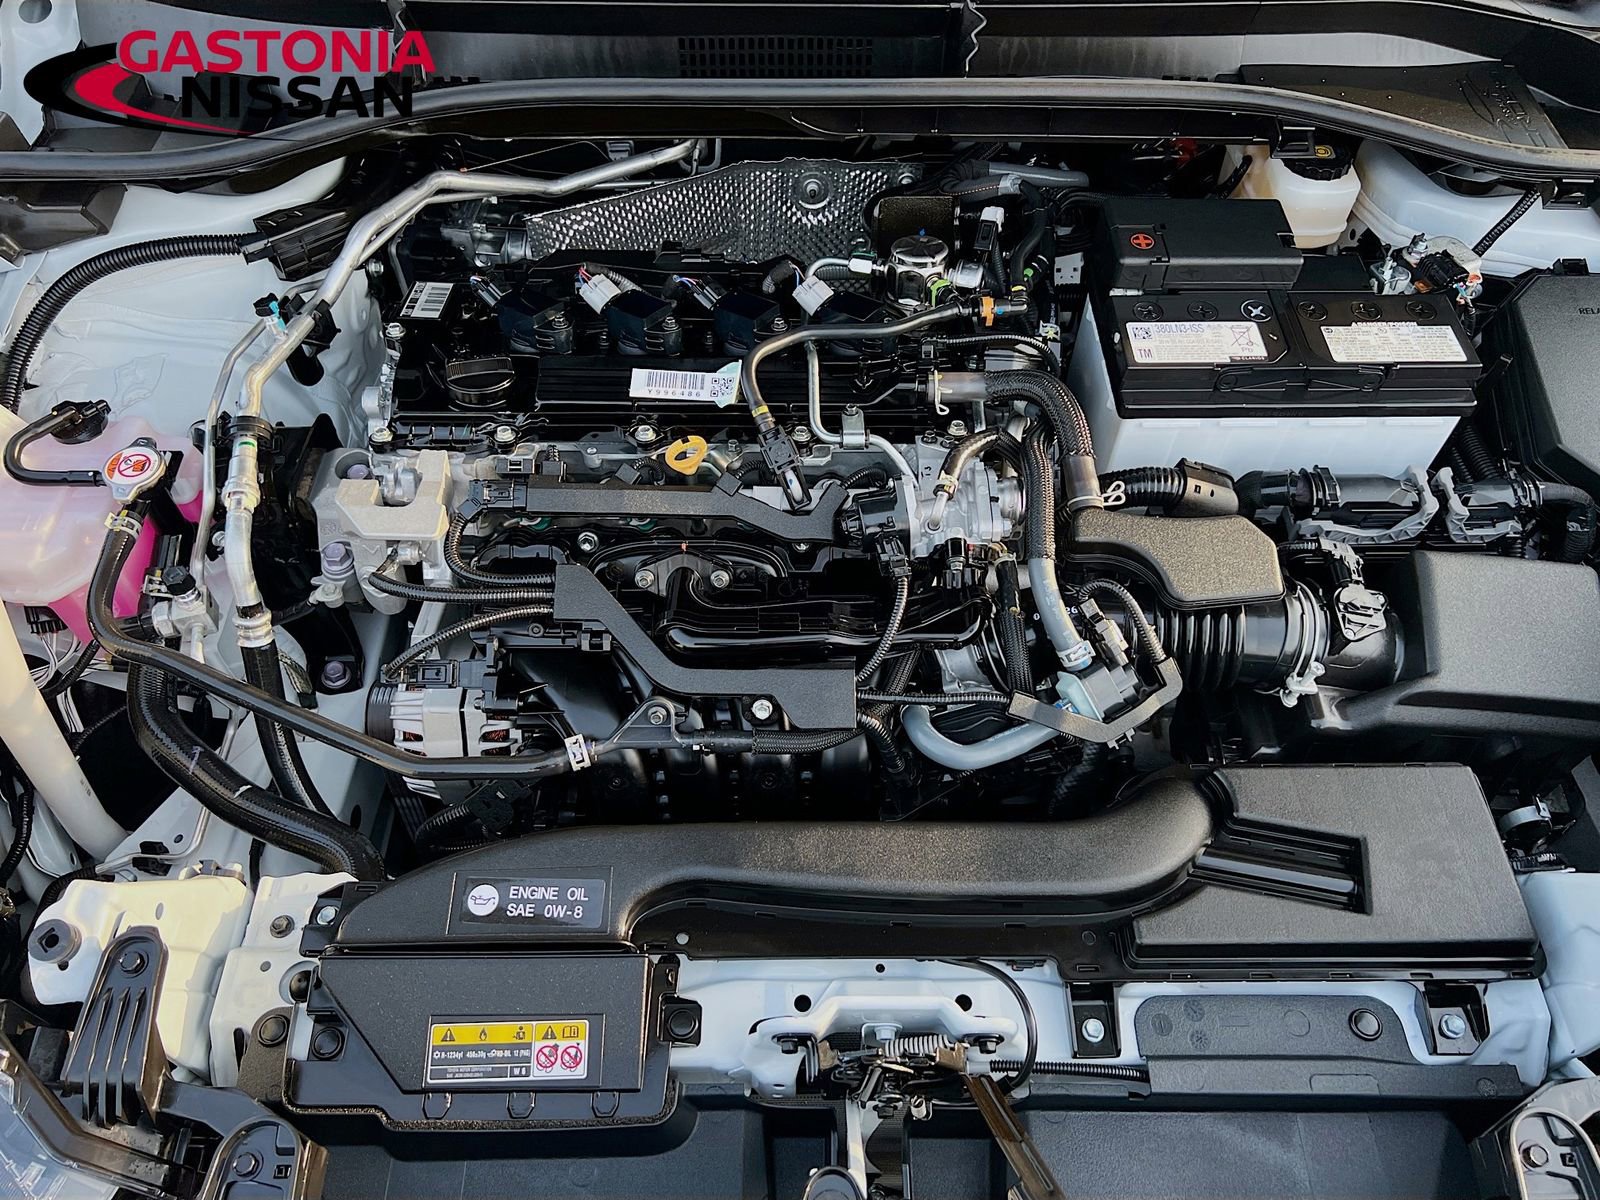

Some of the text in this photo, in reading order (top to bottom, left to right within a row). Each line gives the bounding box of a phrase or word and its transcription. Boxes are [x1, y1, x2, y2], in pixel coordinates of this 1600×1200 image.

[1155, 324, 1205, 334] 380LN3-ISS
[1137, 348, 1153, 359] TM
[647, 389, 701, 398] Y996486
[508, 886, 589, 901] ENGINE OIL
[506, 903, 583, 919] SAE 0W-8
